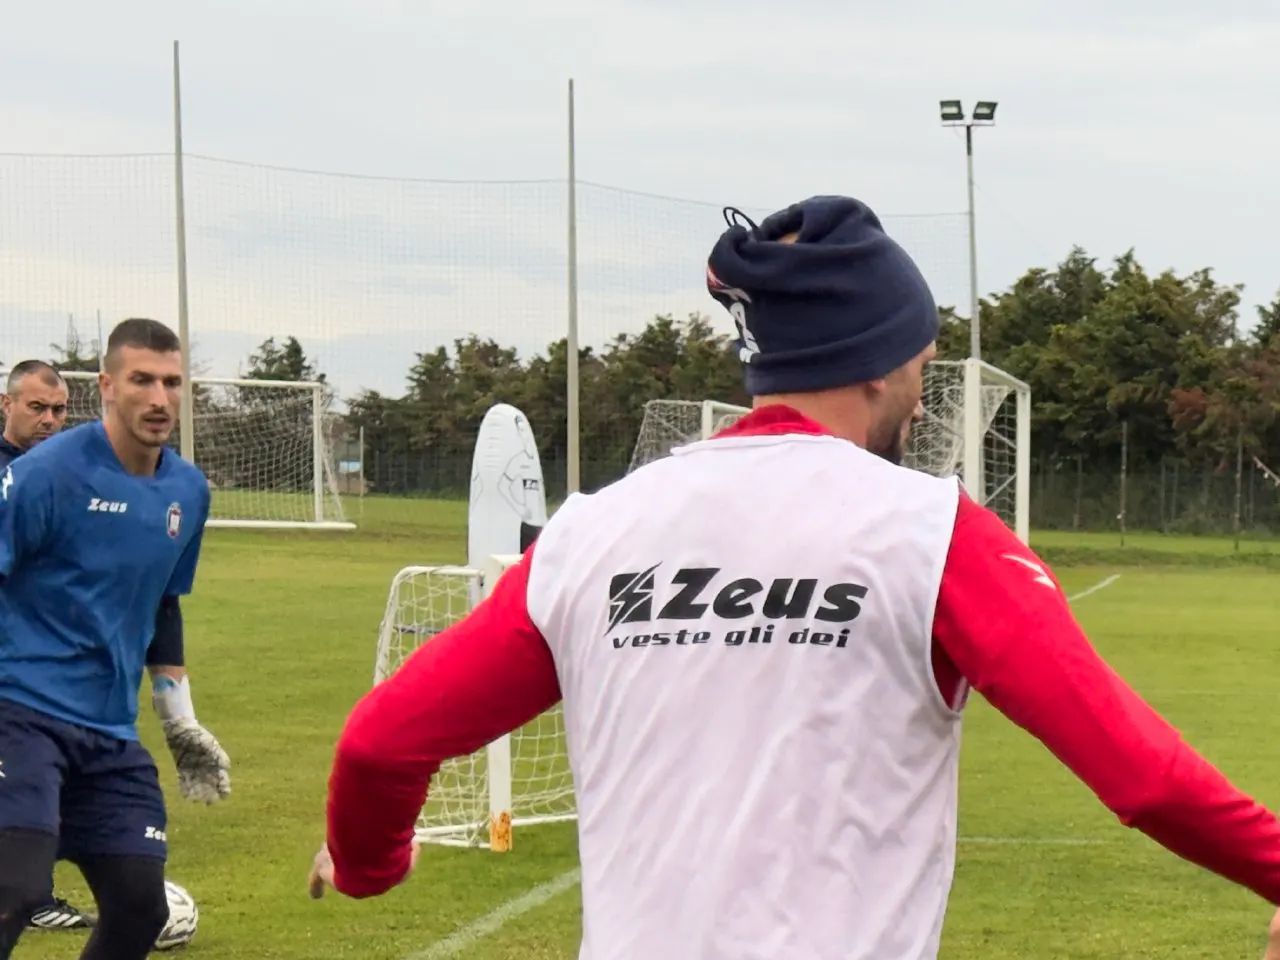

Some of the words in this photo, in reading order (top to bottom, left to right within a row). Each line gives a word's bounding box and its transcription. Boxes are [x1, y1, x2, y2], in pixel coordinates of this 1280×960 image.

[87, 497, 128, 513] Zeus
[655, 566, 870, 624] Zeus
[612, 628, 713, 650] veste
[723, 624, 776, 647] gli
[788, 627, 852, 649] dei
